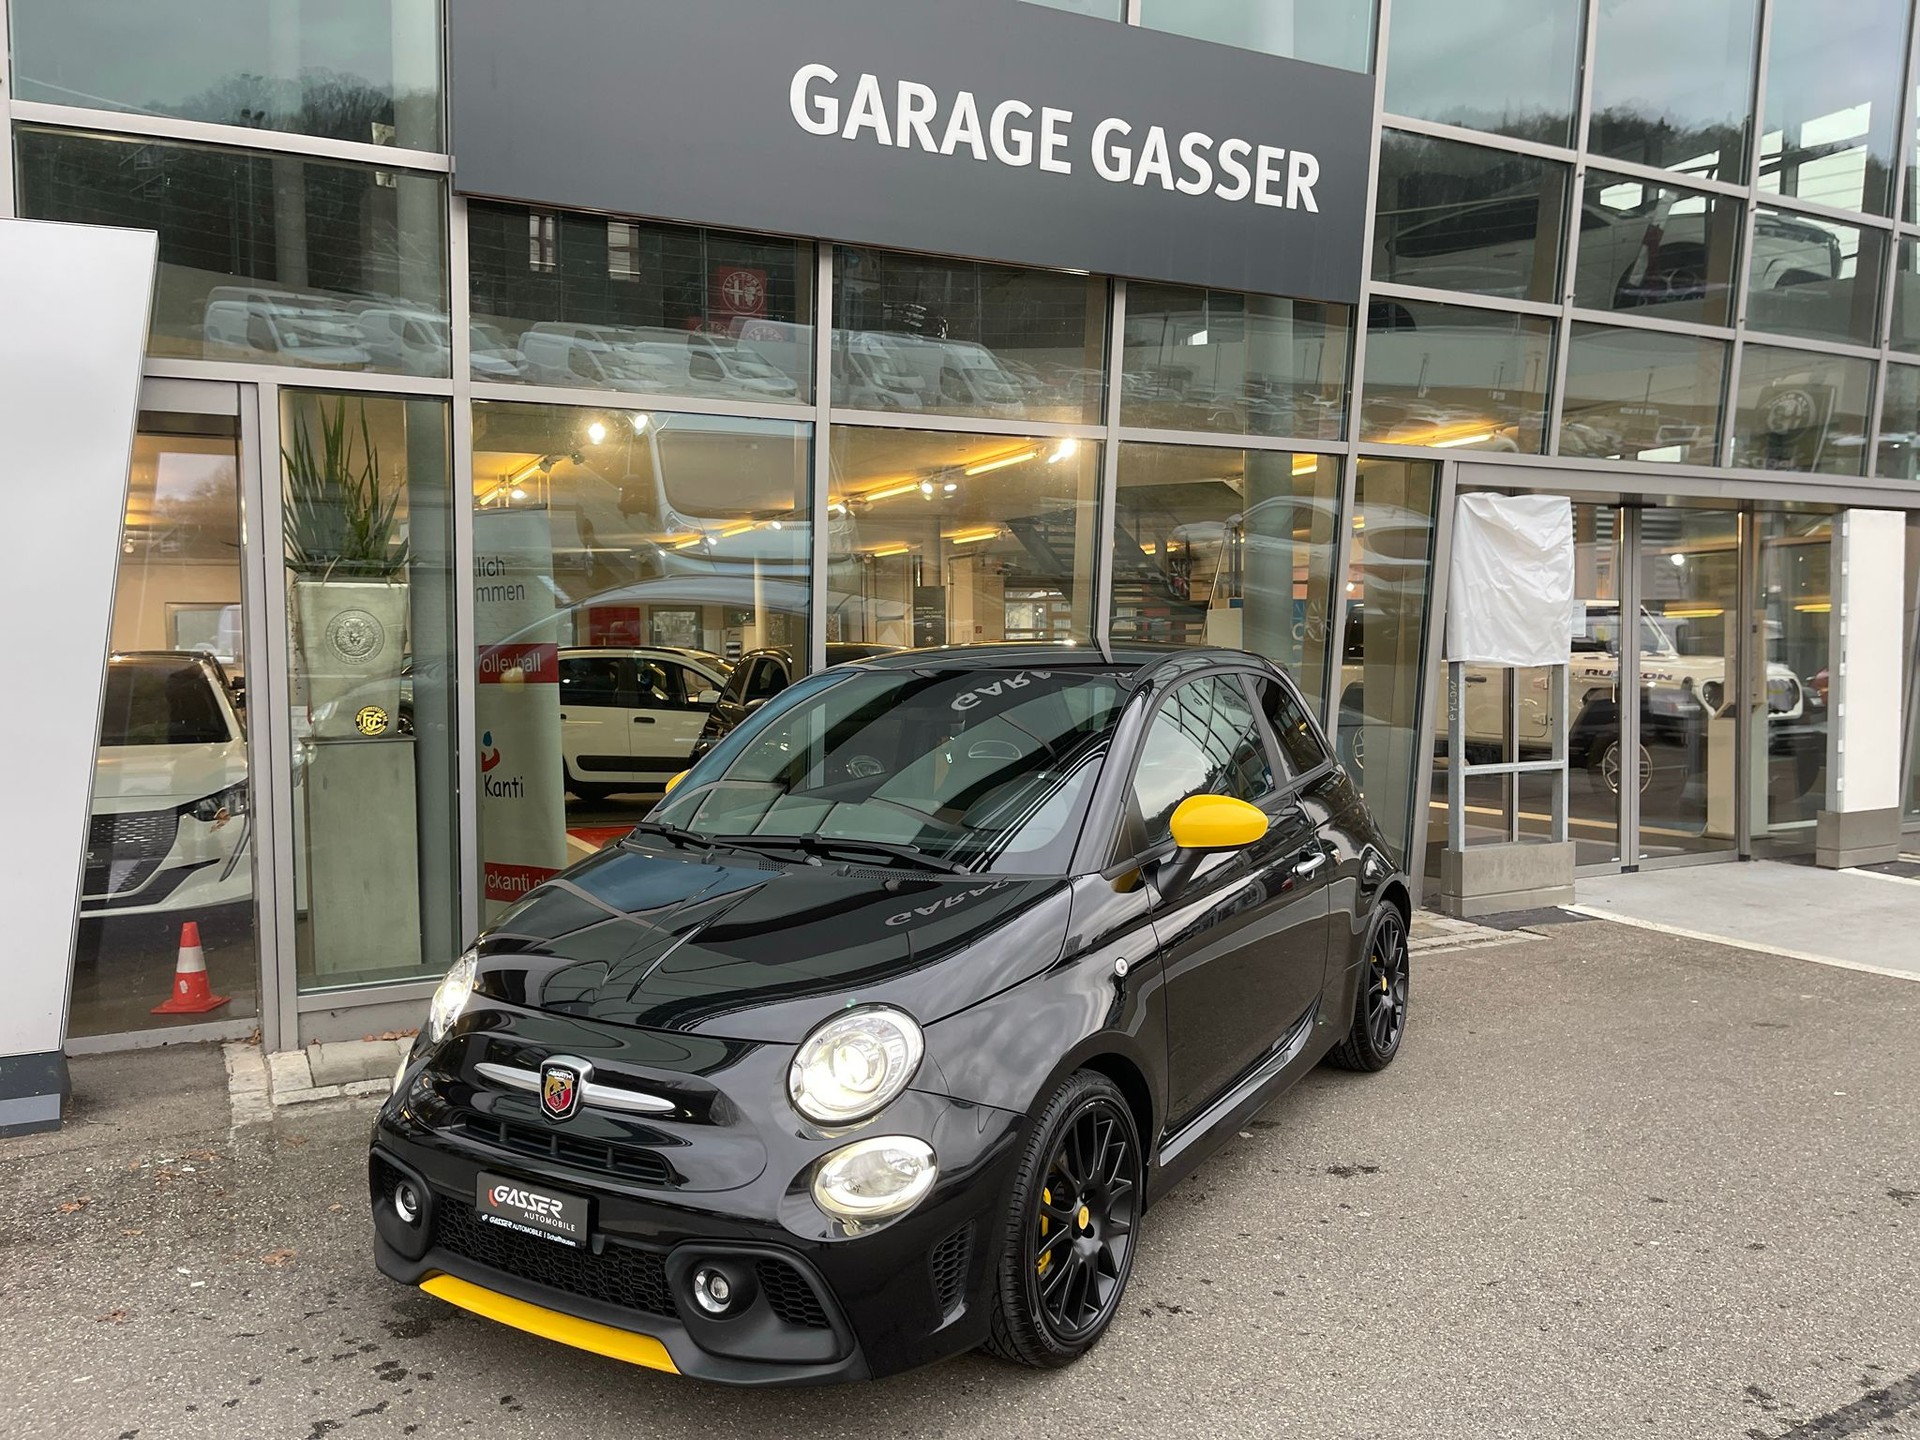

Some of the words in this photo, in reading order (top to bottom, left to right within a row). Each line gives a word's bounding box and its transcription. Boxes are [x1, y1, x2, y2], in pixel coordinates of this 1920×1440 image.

[789, 63, 1073, 174] GARAGE
[1091, 117, 1321, 213] GASSER
[475, 555, 506, 577] lich
[1584, 669, 1673, 680] RUON
[484, 774, 524, 798] Kanti
[494, 1185, 563, 1219] GASSER
[523, 1211, 576, 1232] AUTOMOBILE
[512, 1223, 543, 1238] AUTOMOBILE
[547, 1232, 576, 1247] Schaffhausen
